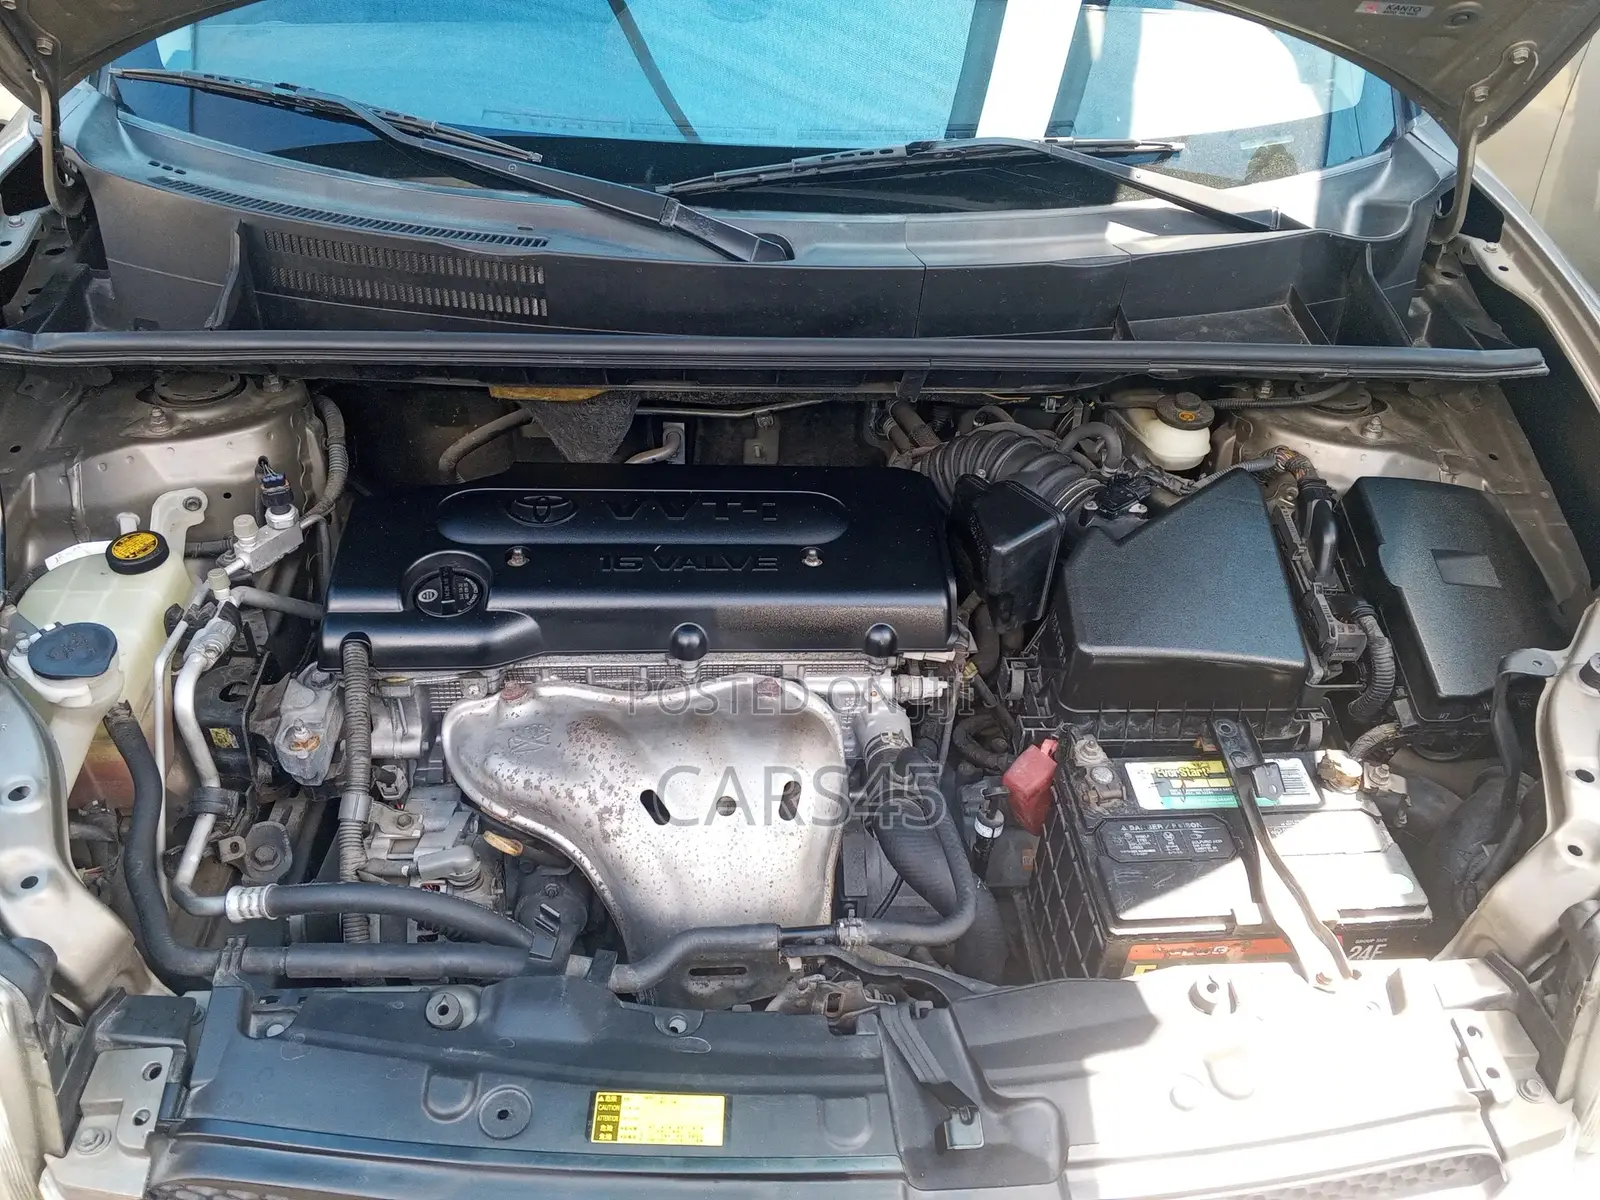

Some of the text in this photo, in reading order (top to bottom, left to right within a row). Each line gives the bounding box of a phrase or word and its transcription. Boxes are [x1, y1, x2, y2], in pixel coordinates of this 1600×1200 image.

[1386, 3, 1422, 13] KANTO
[599, 553, 779, 572] 16 VALVE
[598, 1103, 621, 1112] CAUTION
